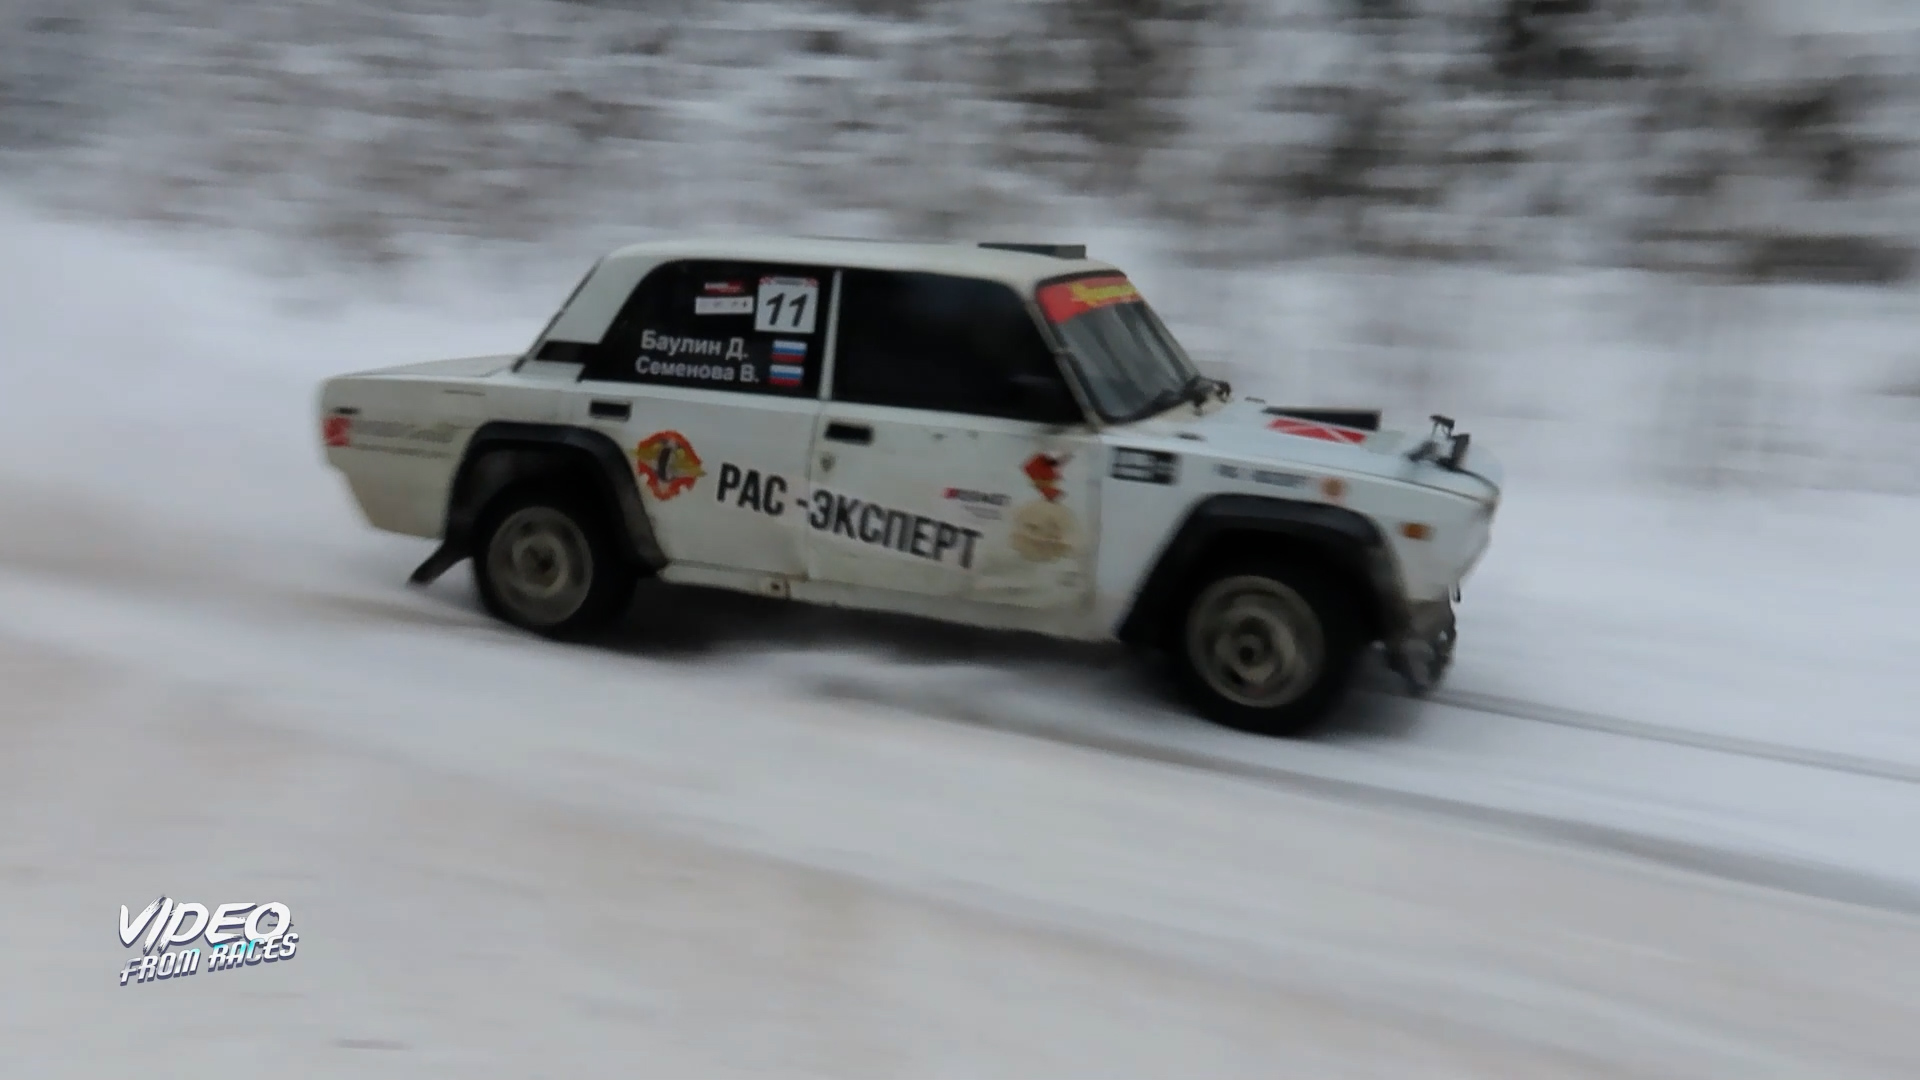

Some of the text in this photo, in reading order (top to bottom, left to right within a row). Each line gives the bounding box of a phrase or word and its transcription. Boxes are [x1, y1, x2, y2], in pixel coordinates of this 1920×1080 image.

[765, 291, 810, 328] 11
[640, 328, 749, 361] Баулин Д.
[634, 355, 760, 384] Семенова В.
[715, 462, 788, 517] РАС
